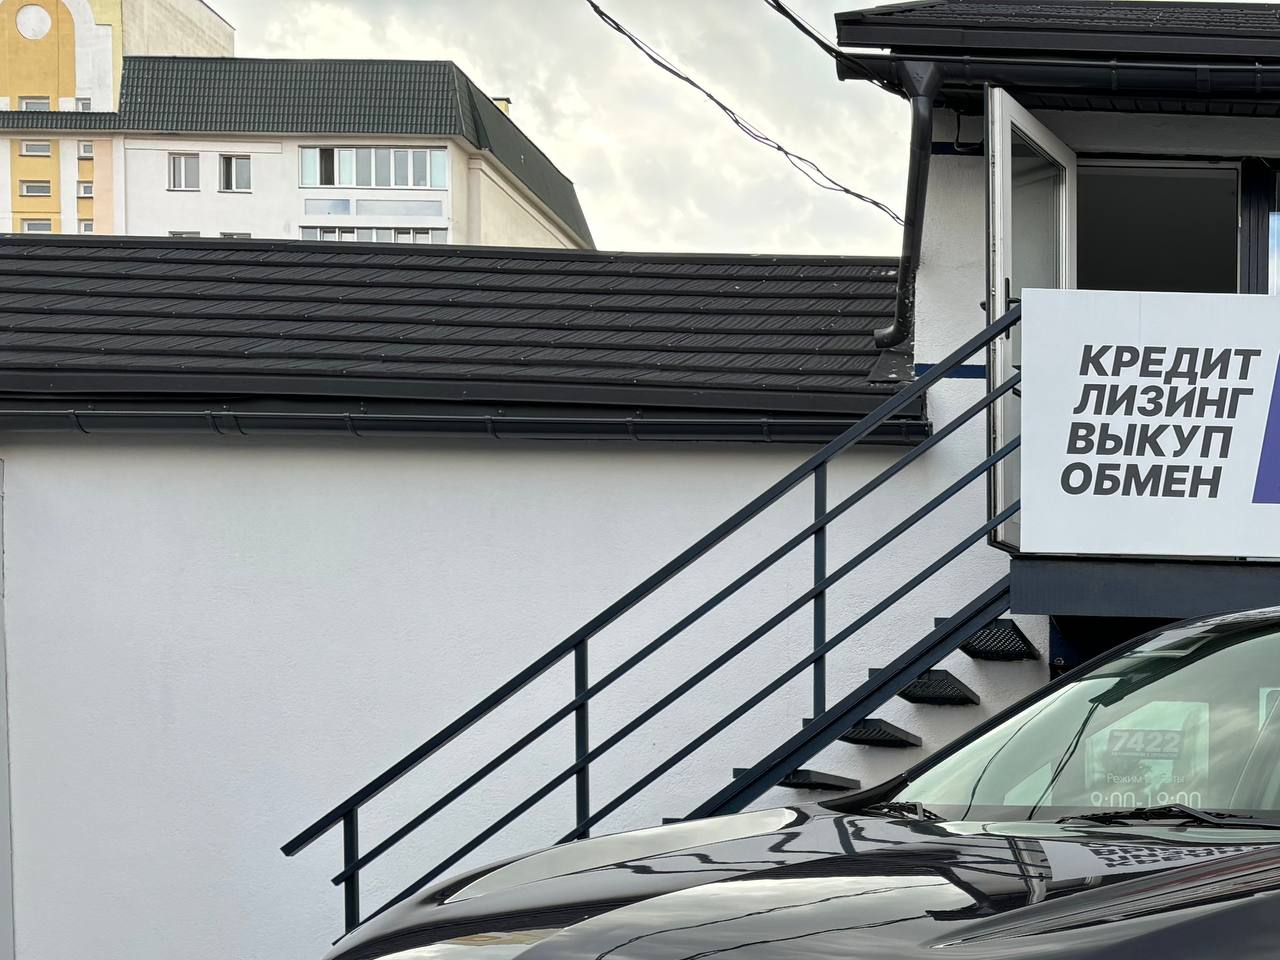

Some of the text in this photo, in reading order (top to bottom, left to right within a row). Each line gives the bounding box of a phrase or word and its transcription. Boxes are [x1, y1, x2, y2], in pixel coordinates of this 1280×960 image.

[1079, 344, 1262, 385] КРЕДИТ
[1072, 383, 1254, 419] ЛИЗИНГ
[1066, 421, 1233, 459] ВЫКУП
[1060, 461, 1223, 499] ОБМЕН
[1111, 730, 1182, 753] 7422
